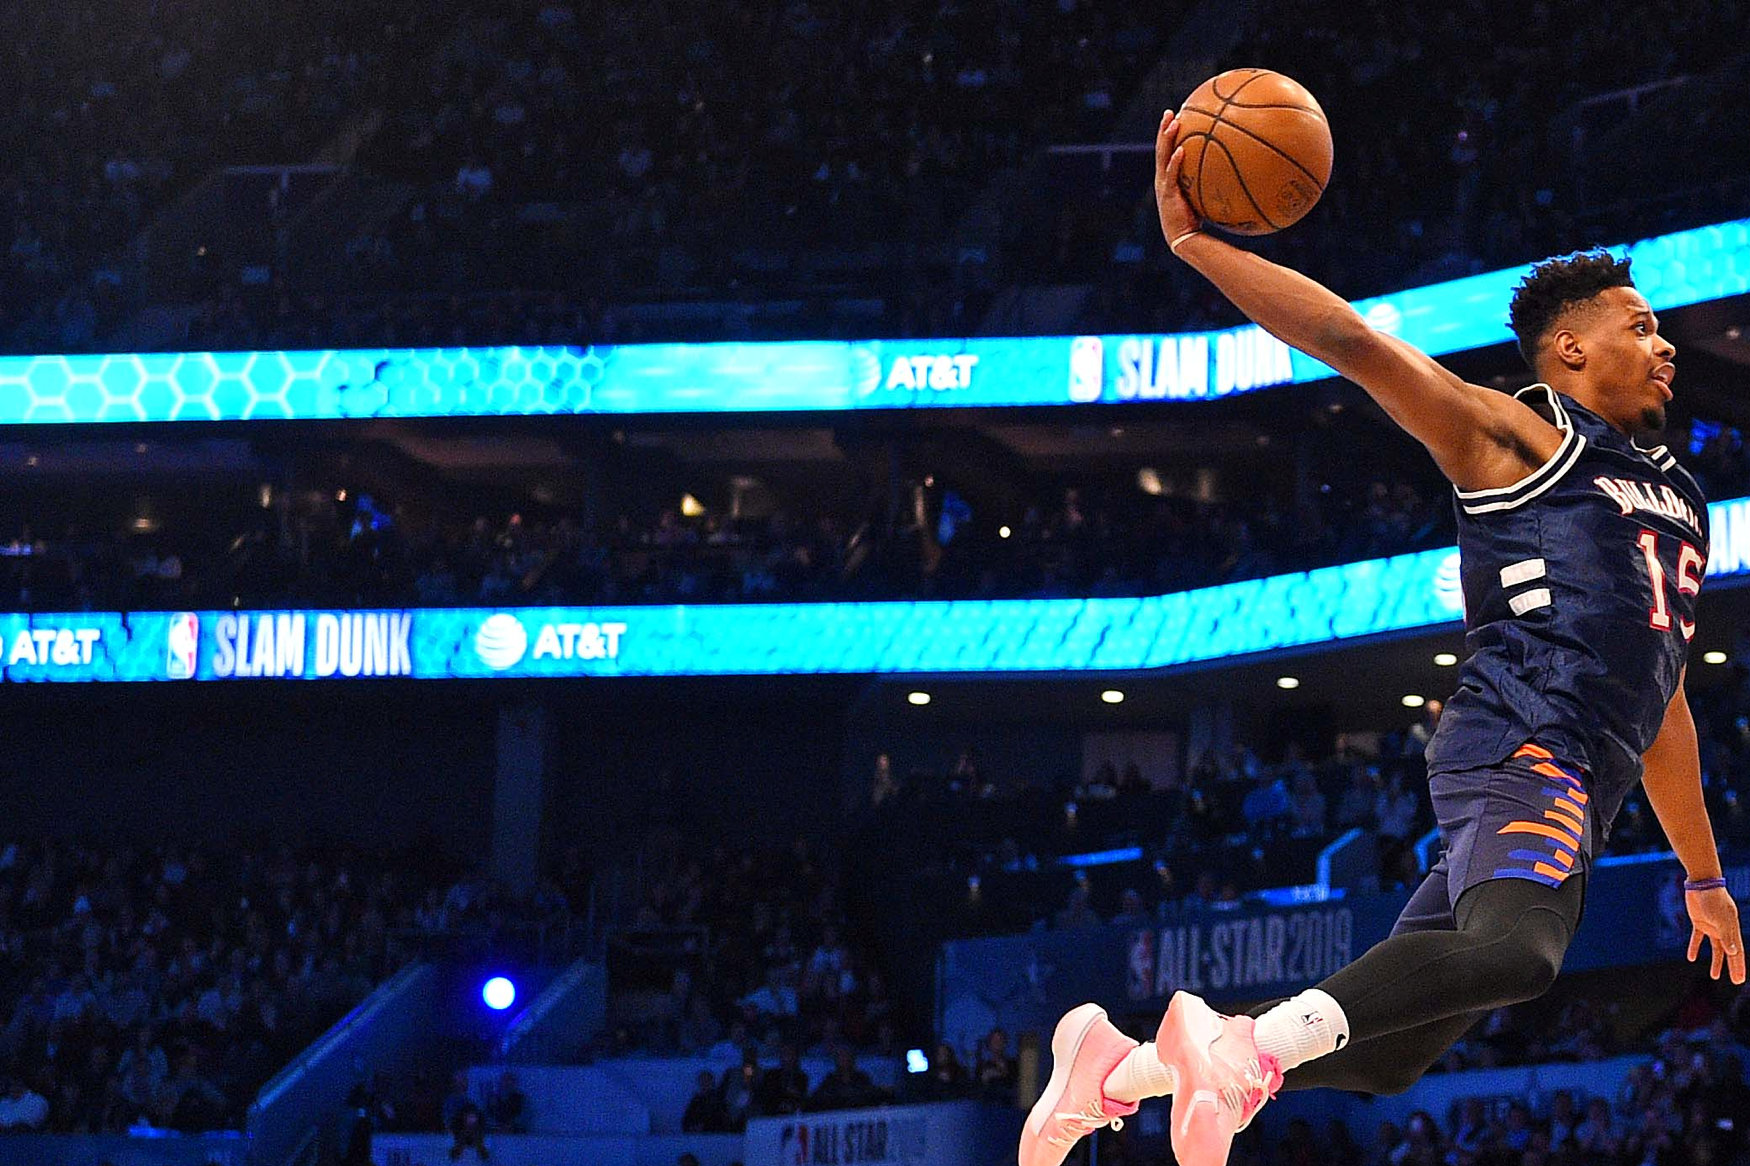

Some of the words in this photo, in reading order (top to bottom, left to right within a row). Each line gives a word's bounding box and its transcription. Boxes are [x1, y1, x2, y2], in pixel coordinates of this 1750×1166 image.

[885, 354, 979, 391] AT&T
[1116, 337, 1208, 400] SLAM
[1592, 476, 1702, 538] BULLDO
[1636, 529, 1706, 643] 15
[9, 629, 100, 665] AT&T
[213, 614, 304, 678] SLAM
[315, 612, 412, 677] DUNK
[533, 622, 627, 660] AT&T
